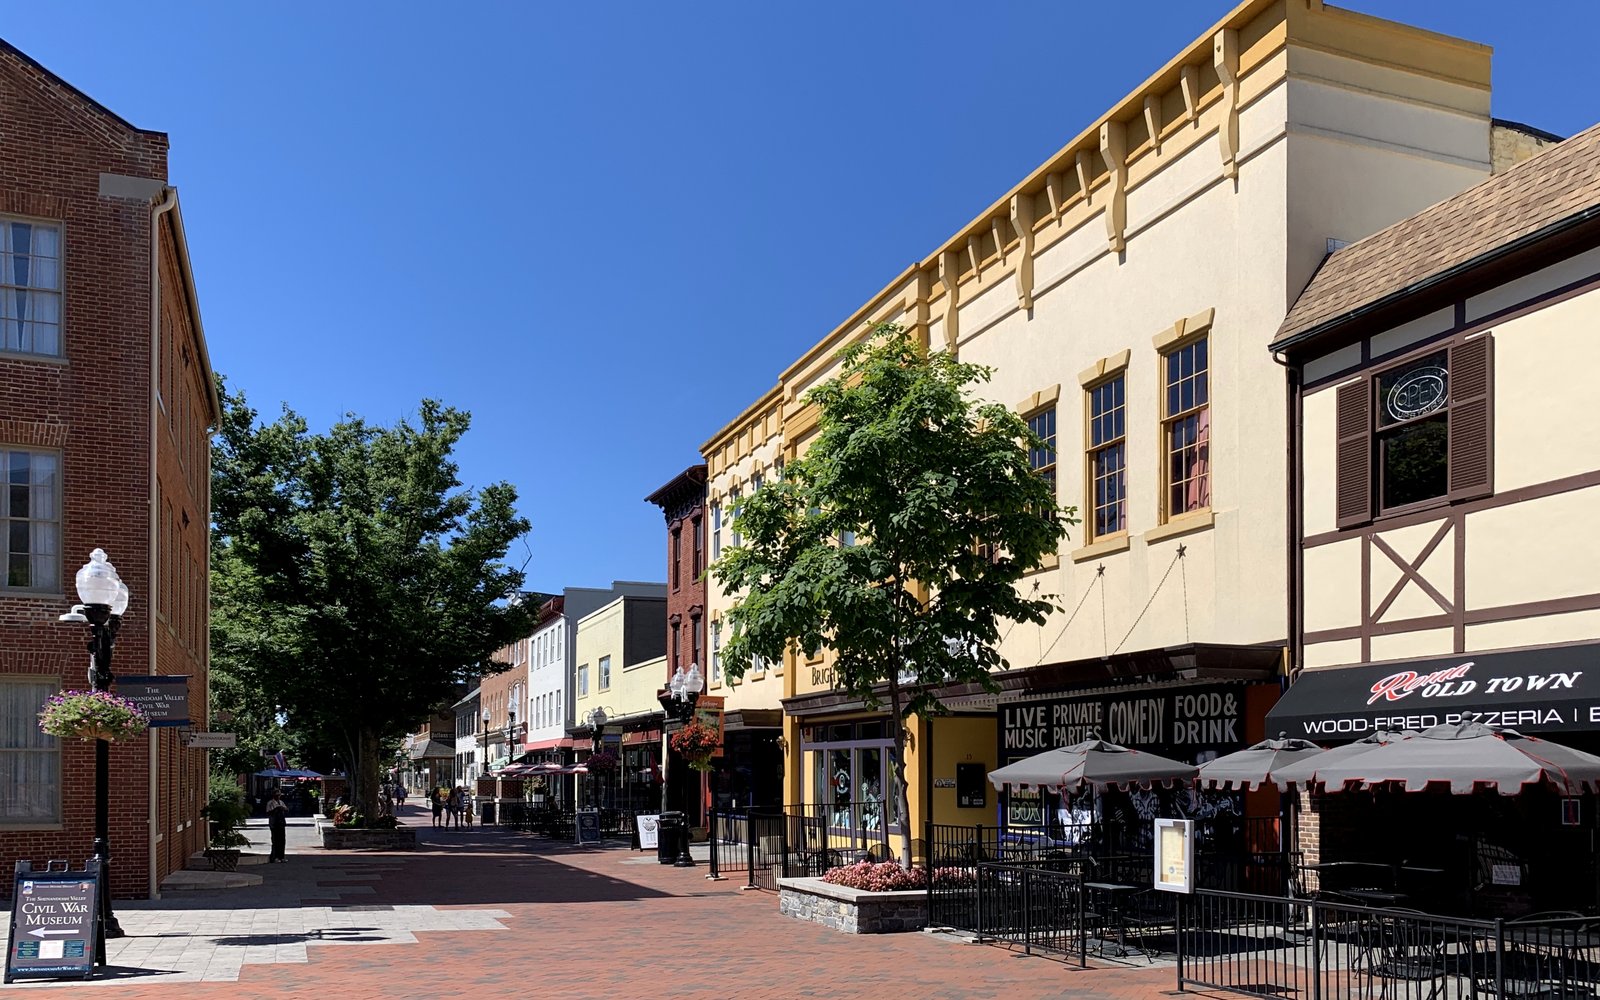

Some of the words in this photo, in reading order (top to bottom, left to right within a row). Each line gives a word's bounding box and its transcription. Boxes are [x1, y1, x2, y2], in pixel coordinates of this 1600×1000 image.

[1397, 379, 1441, 407] OPEN
[1421, 680, 1477, 698] OLD
[1484, 671, 1583, 694] TOWN
[1005, 706, 1047, 728] LIVE
[1053, 701, 1102, 725] PRIVATE
[1109, 698, 1165, 745] COMEDY
[1303, 714, 1438, 734] WOOD-FIRED
[1445, 708, 1564, 726] PZZERIA
[1005, 727, 1047, 749] MUSIC
[1174, 718, 1239, 744] DRINK
[1011, 801, 1041, 821] BOX
[21, 902, 57, 914] CIVIL
[60, 902, 88, 913] WAR
[25, 914, 83, 926] MUSEUM
